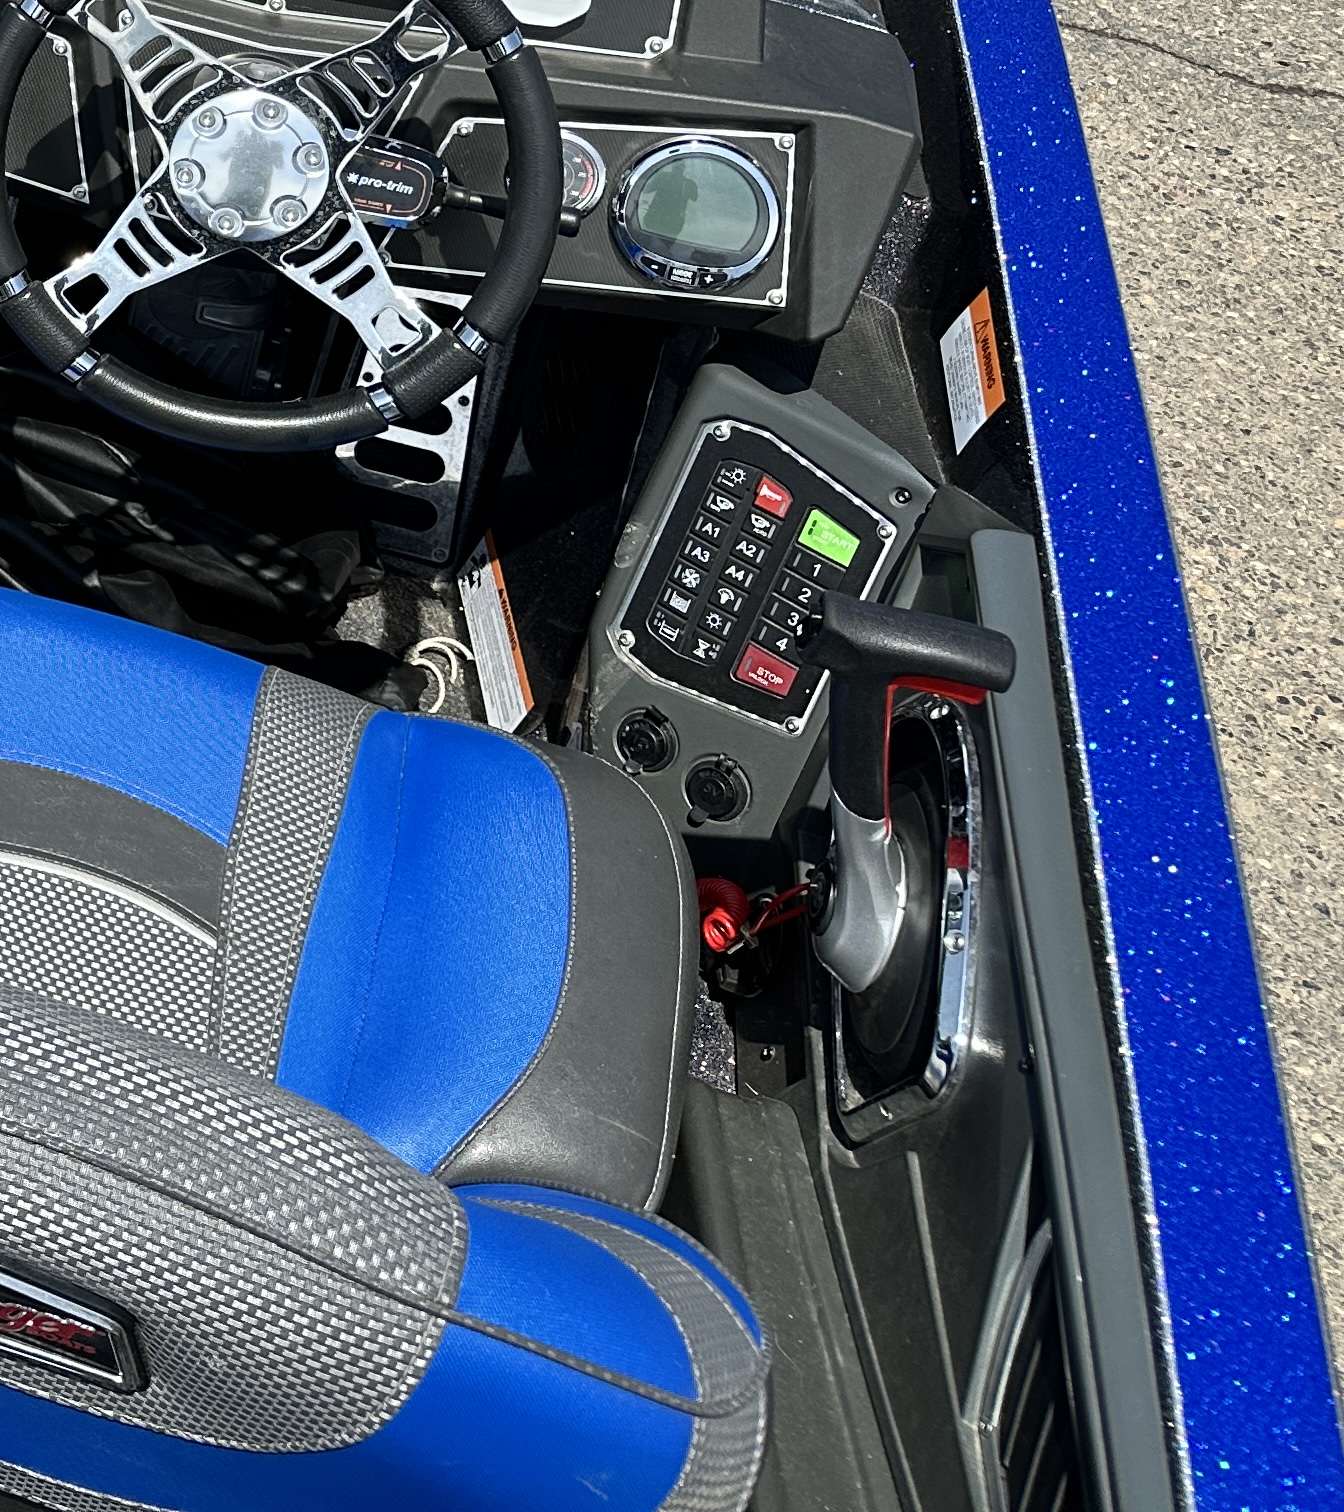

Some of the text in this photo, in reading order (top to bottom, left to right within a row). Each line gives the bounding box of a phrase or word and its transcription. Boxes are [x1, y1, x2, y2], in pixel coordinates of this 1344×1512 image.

[357, 175, 414, 196] pro-trim
[981, 335, 997, 390] WARNING
[700, 521, 721, 538] A1
[735, 539, 758, 558] A2
[820, 530, 855, 552] START
[690, 545, 712, 563] A3
[724, 564, 746, 582] A4
[812, 562, 822, 578] 1
[797, 587, 813, 604] 2
[786, 611, 801, 627] 3
[775, 636, 790, 652] 4
[755, 666, 785, 686] STOP
